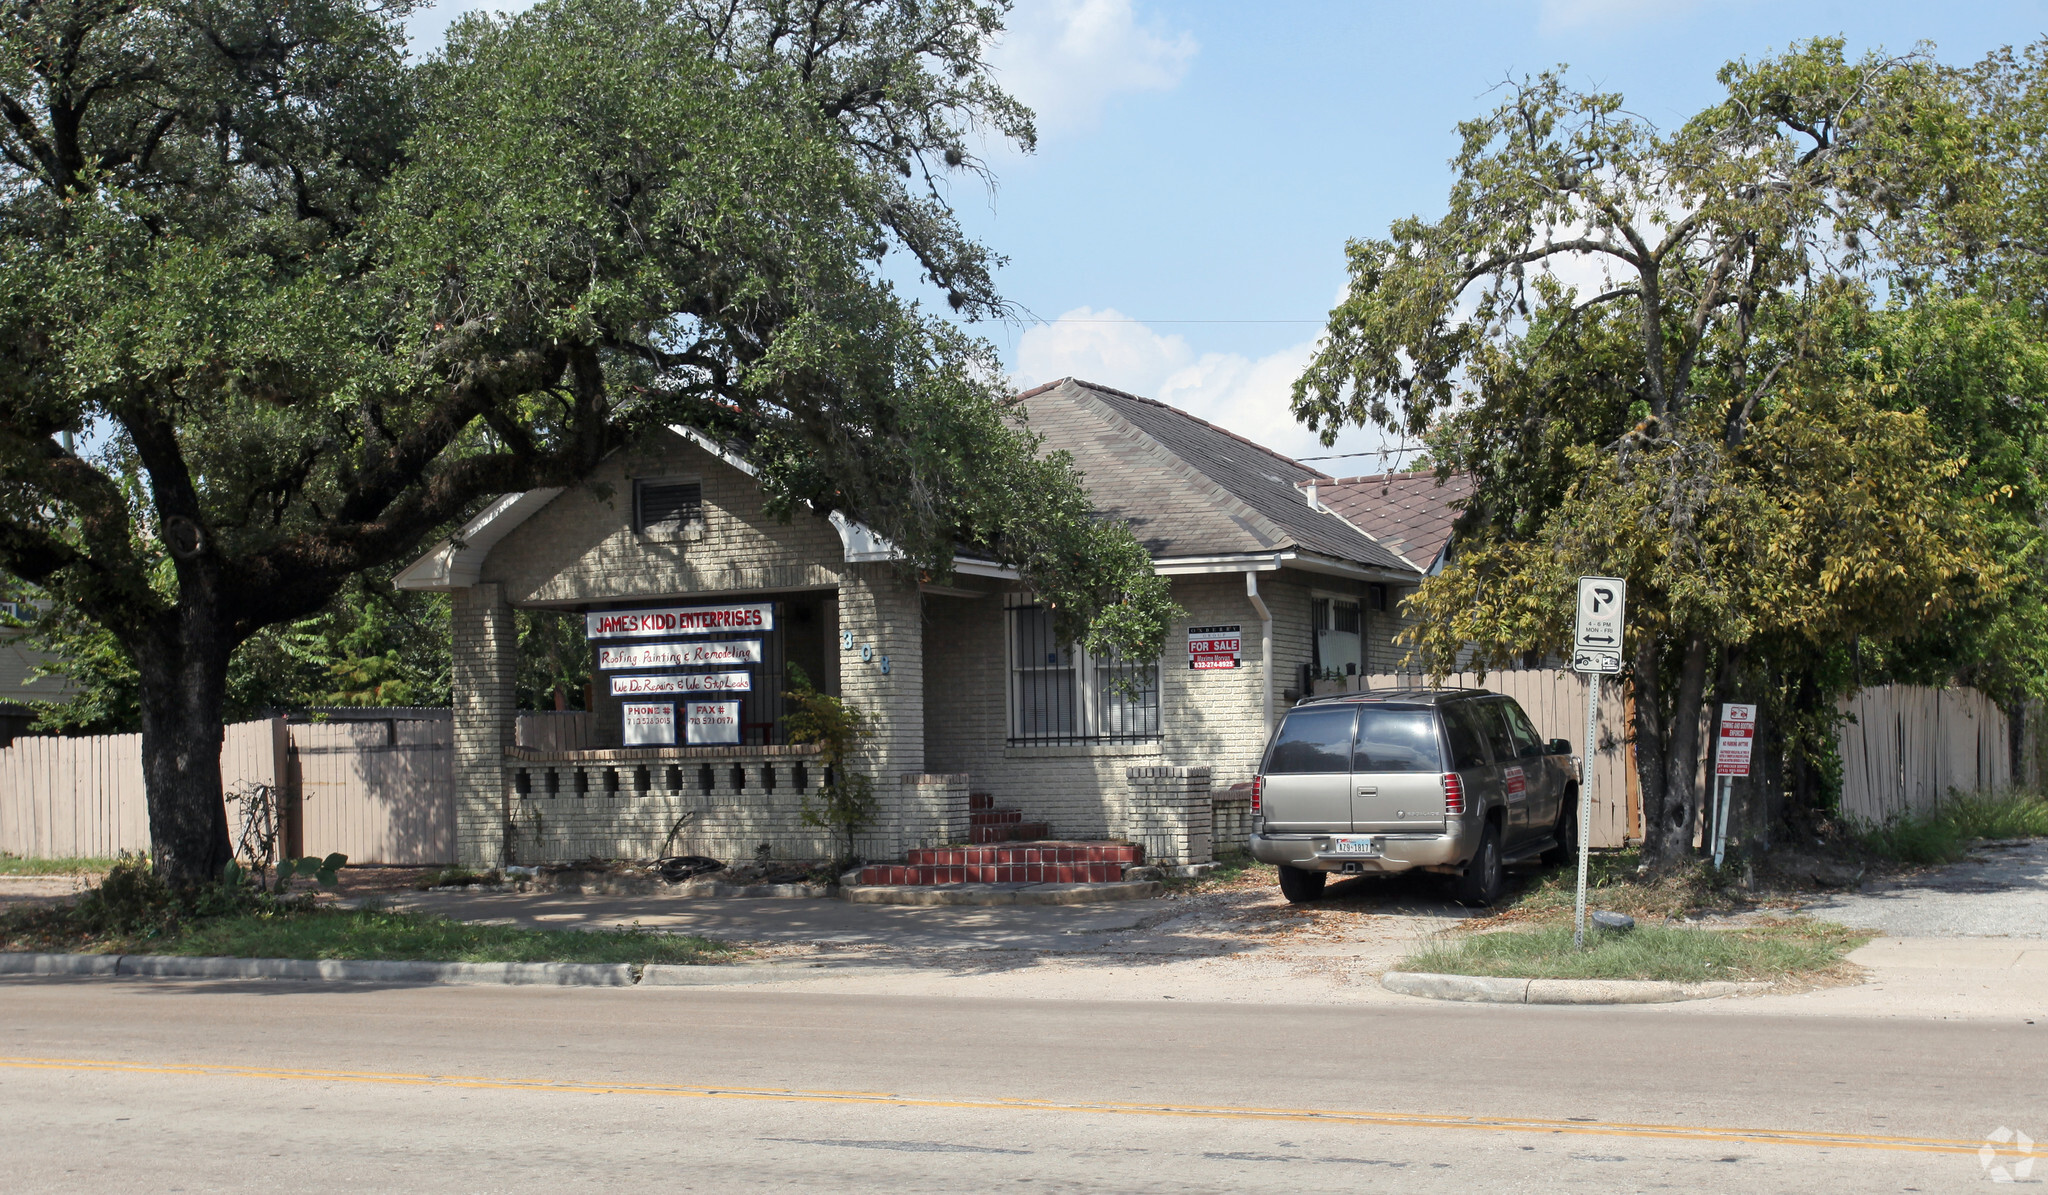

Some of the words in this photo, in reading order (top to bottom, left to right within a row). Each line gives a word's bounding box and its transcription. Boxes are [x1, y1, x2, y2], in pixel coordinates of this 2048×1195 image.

[596, 615, 638, 633] JAMES
[641, 613, 676, 631] KIDD
[680, 609, 762, 628] ENTERPRISES
[1191, 641, 1209, 652] FOR
[1213, 640, 1237, 651] SALE
[643, 650, 681, 665] Painting
[694, 645, 751, 662] Remodeling
[614, 680, 627, 692] We
[629, 679, 641, 691] Do
[643, 679, 674, 692] Repairs
[686, 677, 700, 690] We
[704, 675, 724, 690] Stop
[725, 675, 749, 688] Leaks
[628, 707, 660, 715] PHONE
[663, 707, 671, 715] #
[696, 706, 716, 714] FAX
[718, 705, 725, 714] #
